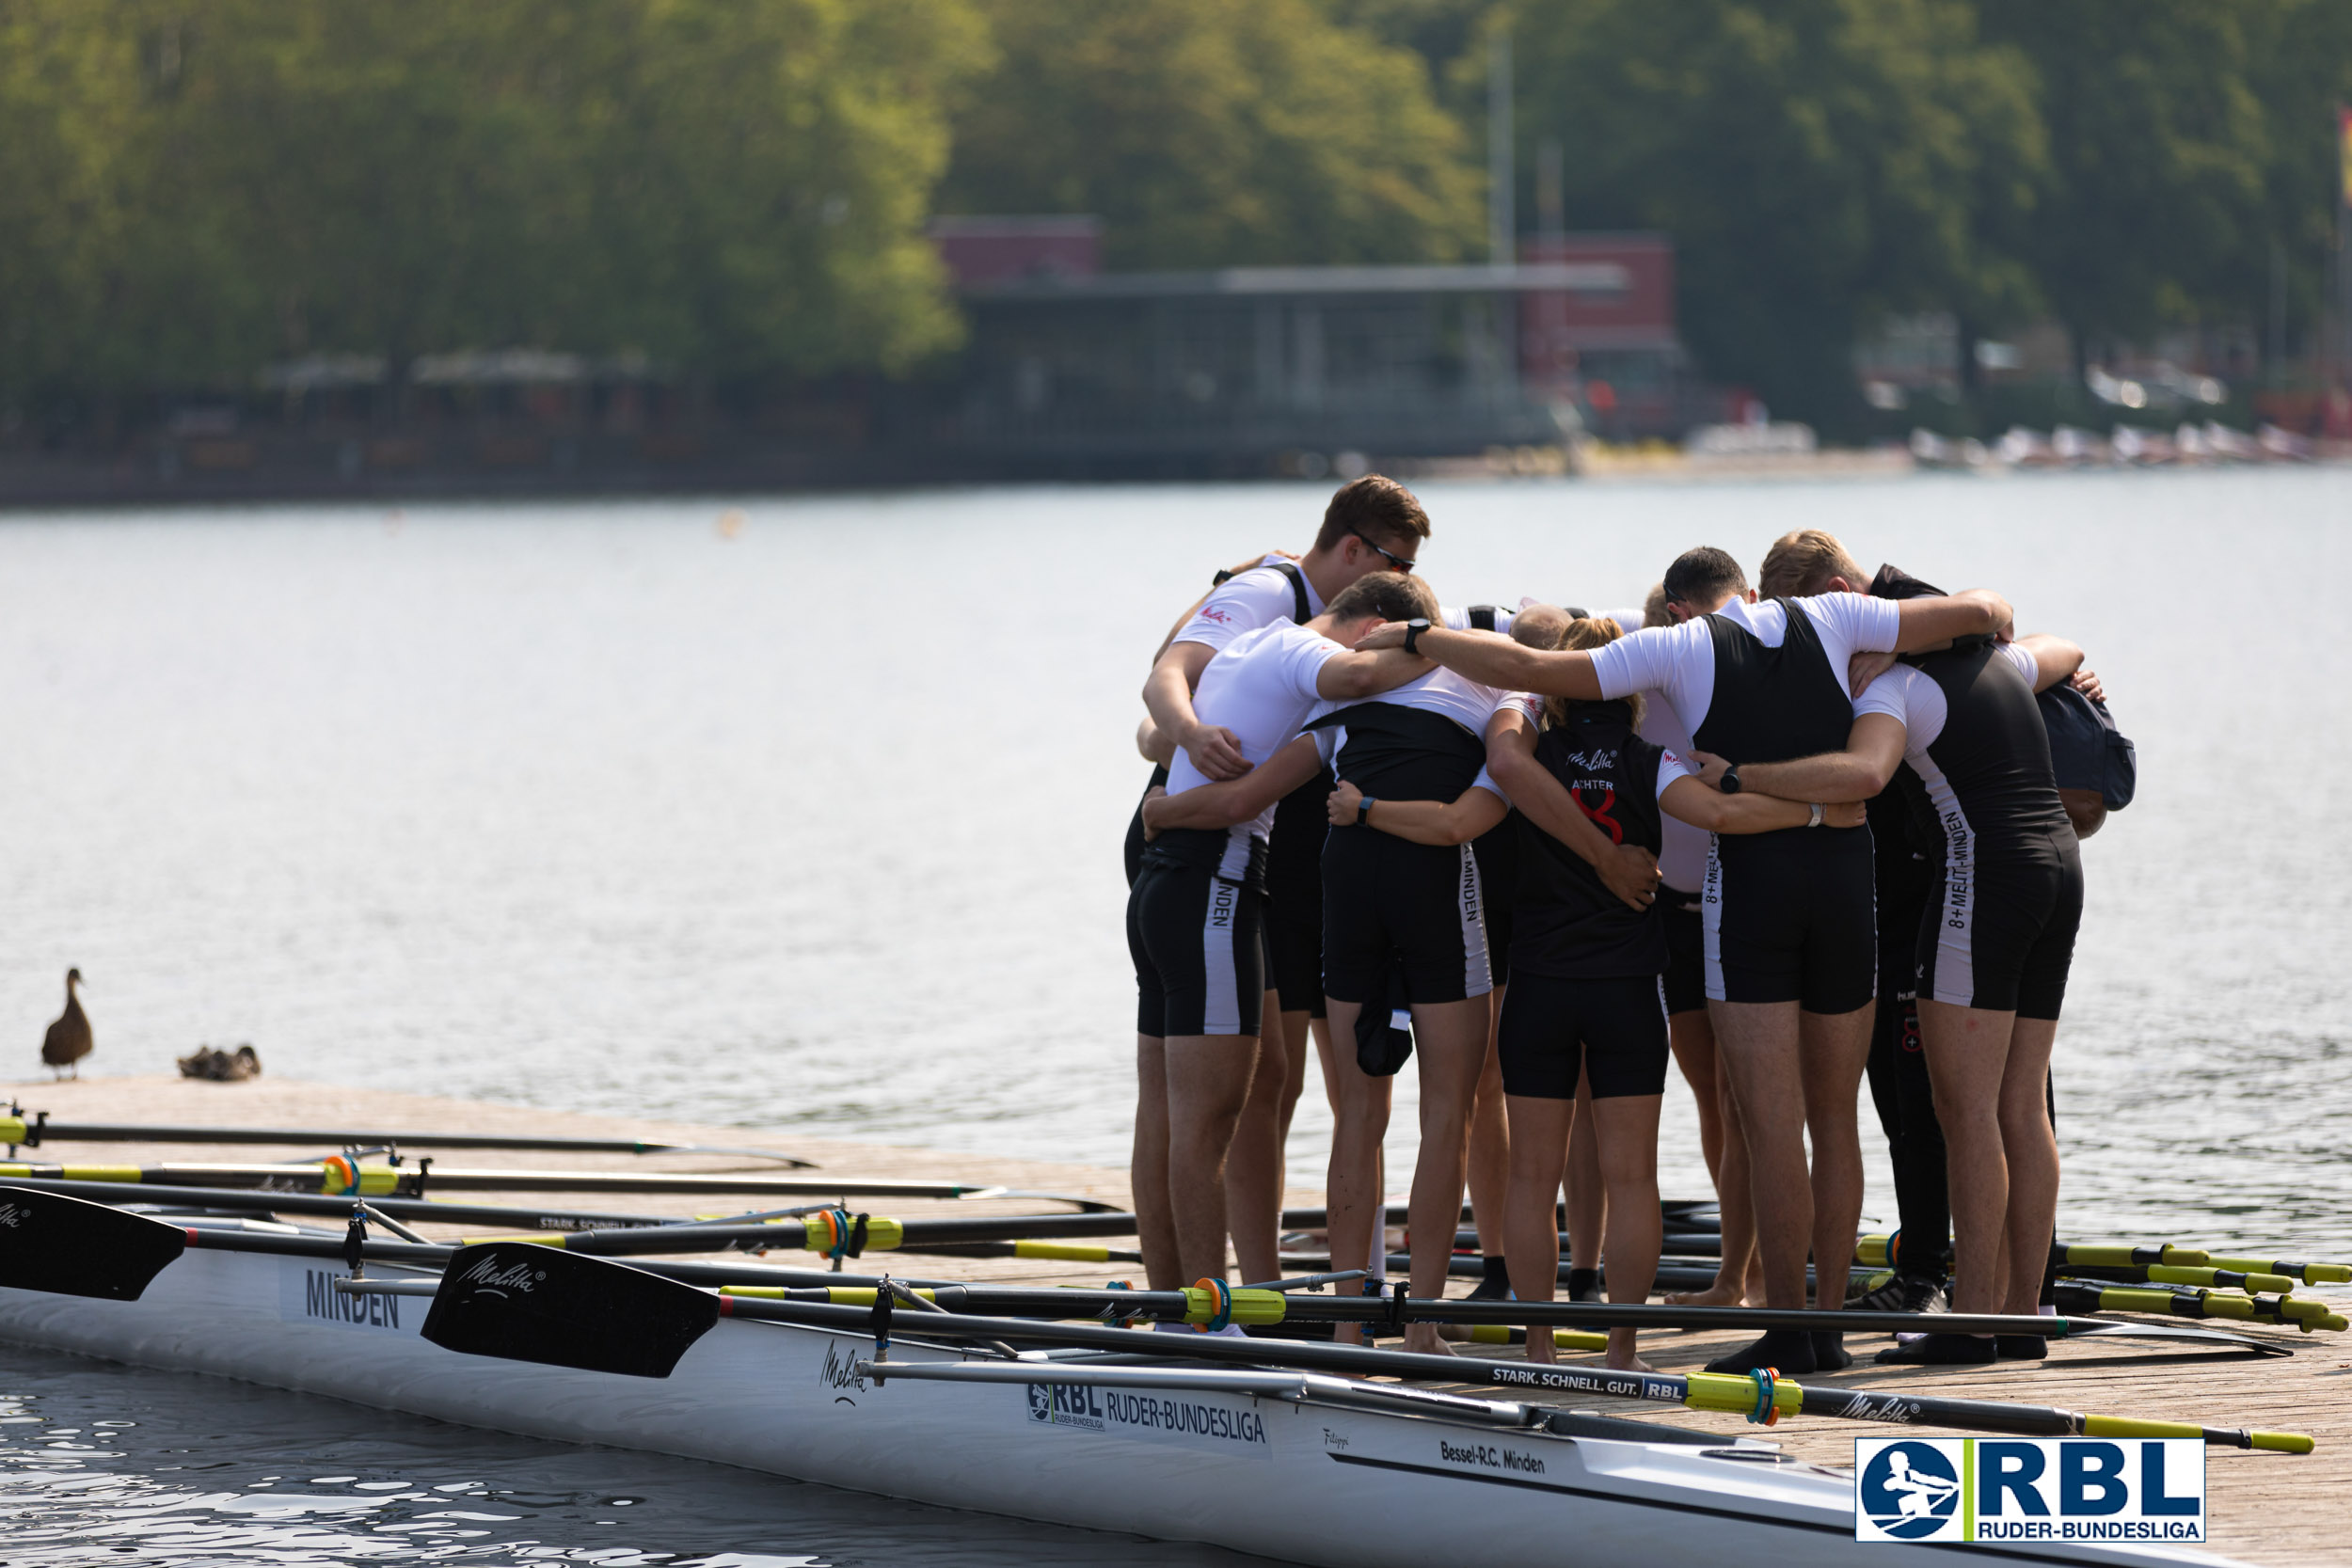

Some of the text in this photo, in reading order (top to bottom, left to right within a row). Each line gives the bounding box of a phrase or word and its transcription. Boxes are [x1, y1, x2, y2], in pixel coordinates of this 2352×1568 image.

[1565, 749, 1613, 771] Melitta
[1572, 779, 1613, 791] ACHTER
[1213, 885, 1233, 927] NDEN
[456, 1253, 534, 1292] Melitta
[307, 1269, 399, 1329] MINDEN
[1493, 1369, 1637, 1396] STARK. SCHNELL. GUT.
[1647, 1383, 1683, 1400] RBL
[1054, 1385, 1103, 1418] RBL
[1106, 1391, 1266, 1444] RUDER-BUNDESLIGA
[1836, 1391, 1912, 1424] Melitta
[1055, 1413, 1104, 1430] RUDER-BUNDESLIGA
[1323, 1428, 1349, 1449] Filippi
[1440, 1440, 1546, 1475] Bessel-R.C. Minden
